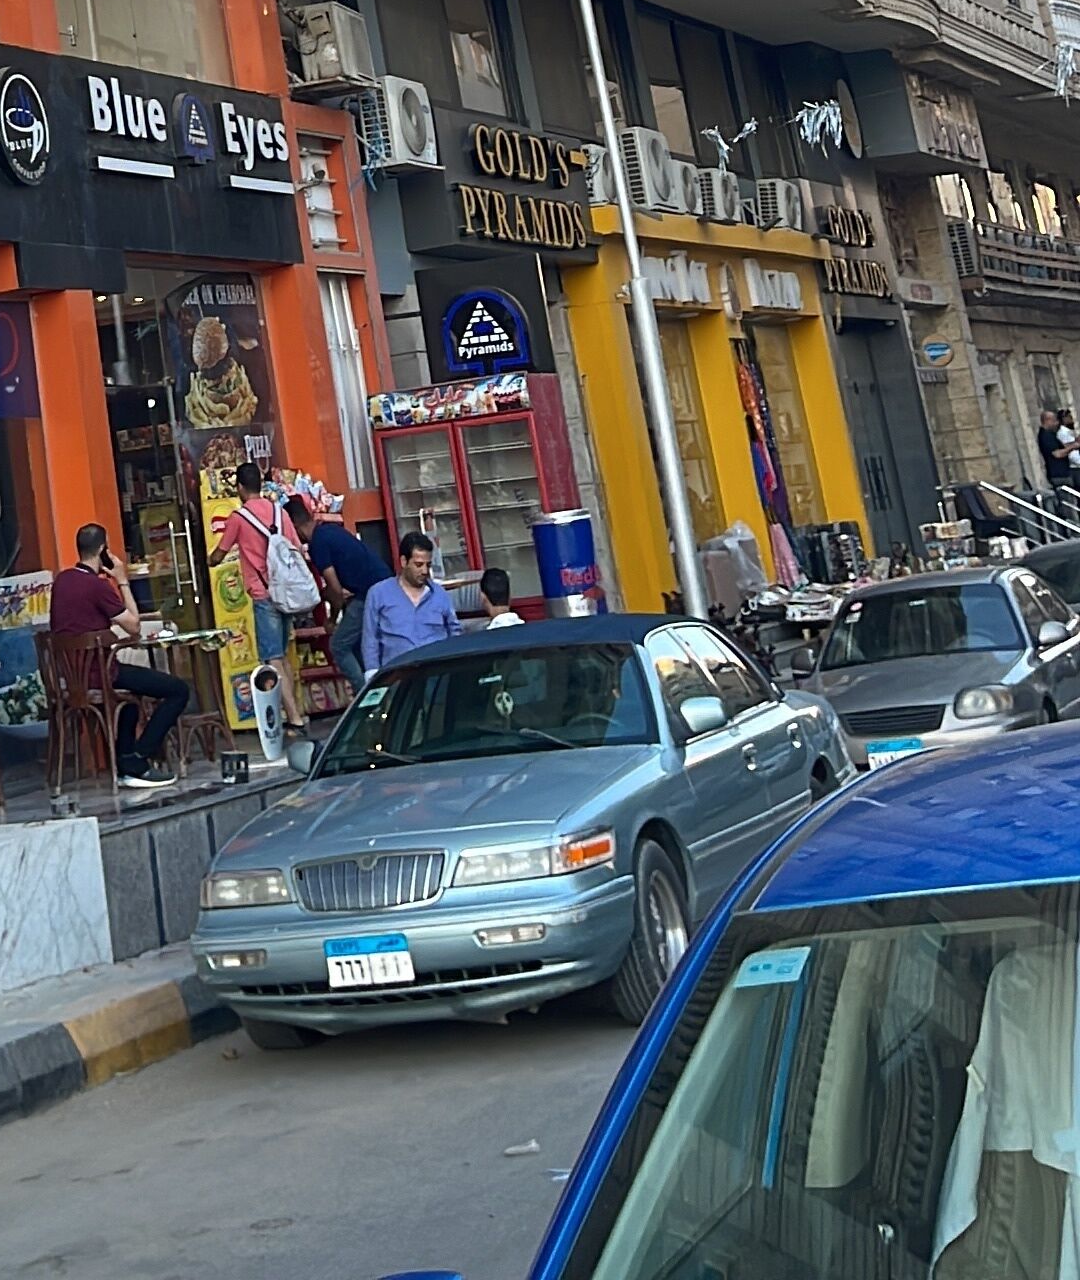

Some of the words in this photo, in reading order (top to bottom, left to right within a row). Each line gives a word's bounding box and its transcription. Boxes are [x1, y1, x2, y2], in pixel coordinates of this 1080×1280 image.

[9, 138, 33, 151] BLUE
[88, 75, 168, 142] Blue
[221, 102, 290, 171] Eyes
[475, 124, 570, 188] GOLD'S
[458, 184, 587, 249] PYRAMIDS
[458, 341, 514, 359] Pyramids
